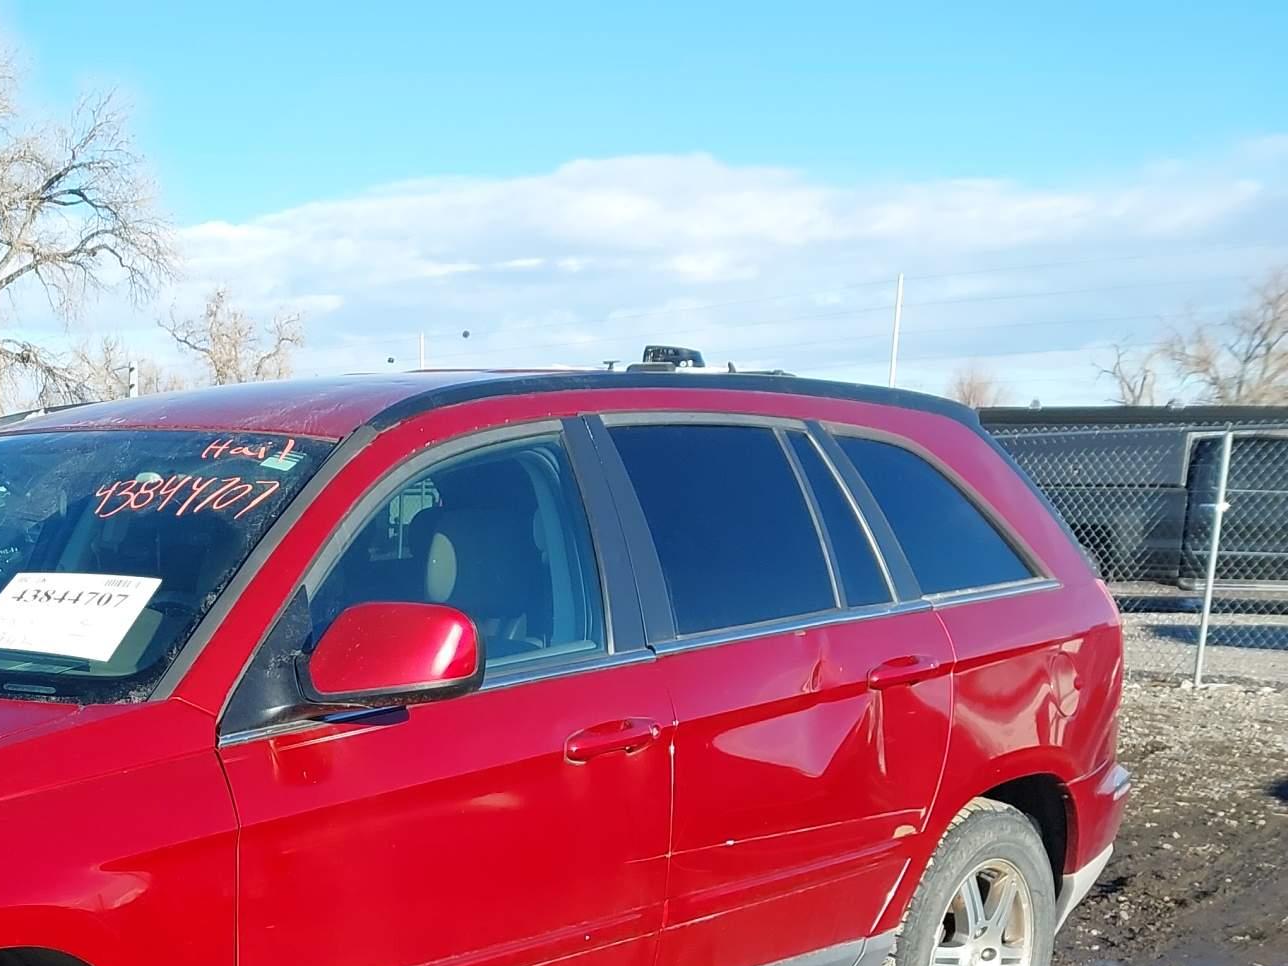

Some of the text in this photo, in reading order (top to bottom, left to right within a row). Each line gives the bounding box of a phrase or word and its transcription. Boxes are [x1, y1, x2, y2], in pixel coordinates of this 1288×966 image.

[201, 439, 295, 463] Hail
[94, 475, 280, 519] 43844707
[12, 588, 129, 608] 43844707
